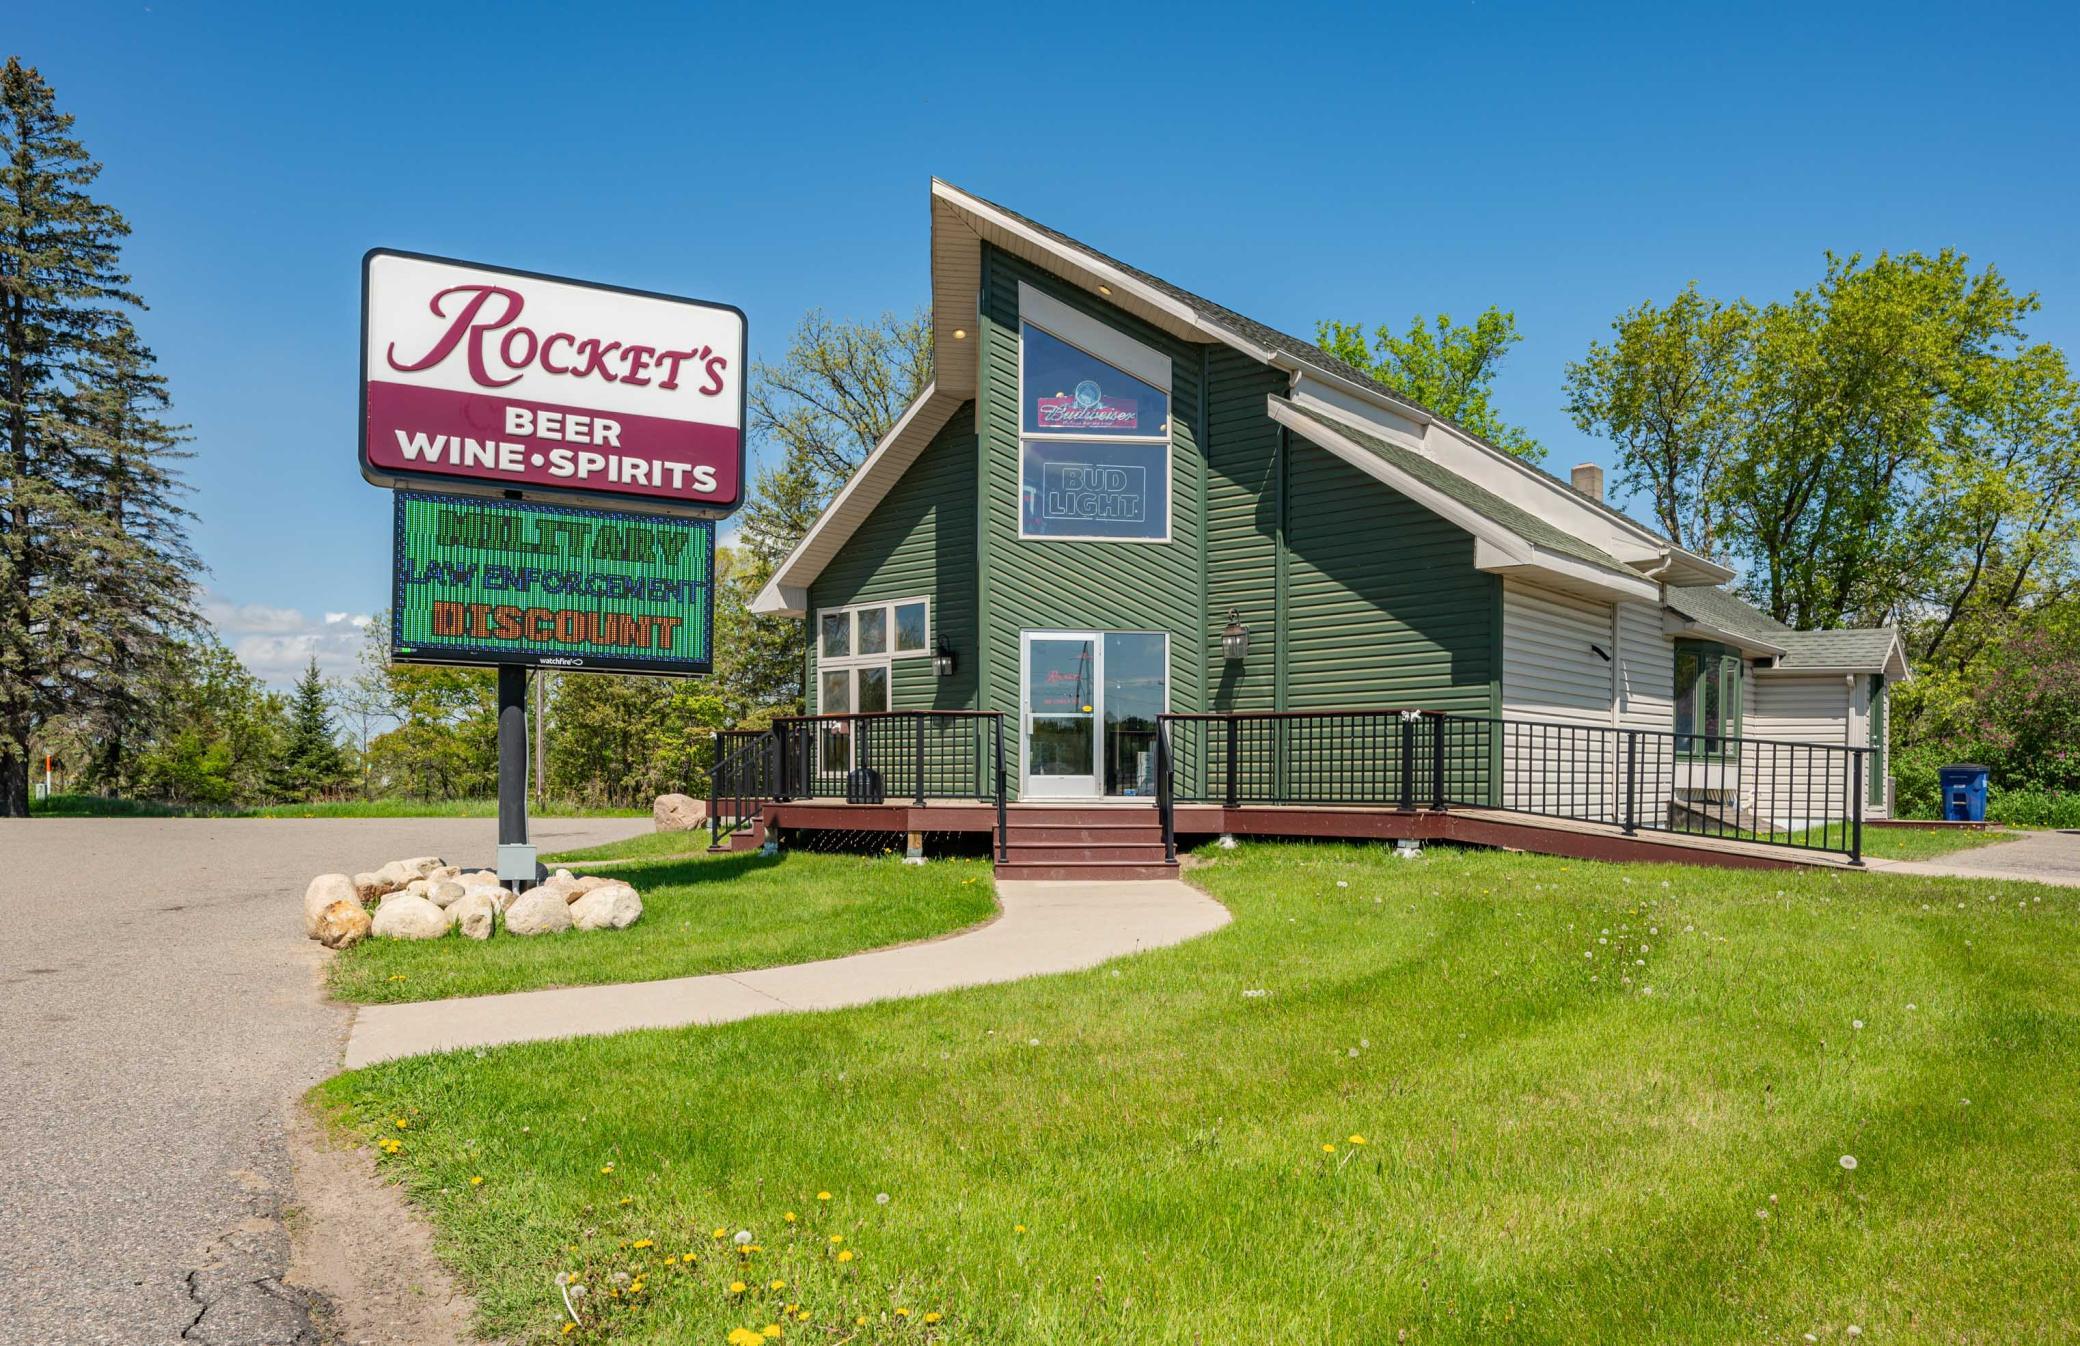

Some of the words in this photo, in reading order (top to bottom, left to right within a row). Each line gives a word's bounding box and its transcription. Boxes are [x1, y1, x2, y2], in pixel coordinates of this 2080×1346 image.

[505, 407, 621, 447] BEER
[1040, 404, 1136, 421] Budweiser
[1062, 468, 1127, 491] BUD
[1049, 492, 1139, 517] LIGHT
[437, 509, 687, 564] MILITARY
[404, 558, 477, 588] LAW
[484, 563, 706, 603] ENFORCEMENT
[432, 600, 682, 649] DISCOUNT
[540, 657, 572, 666] watchfire
